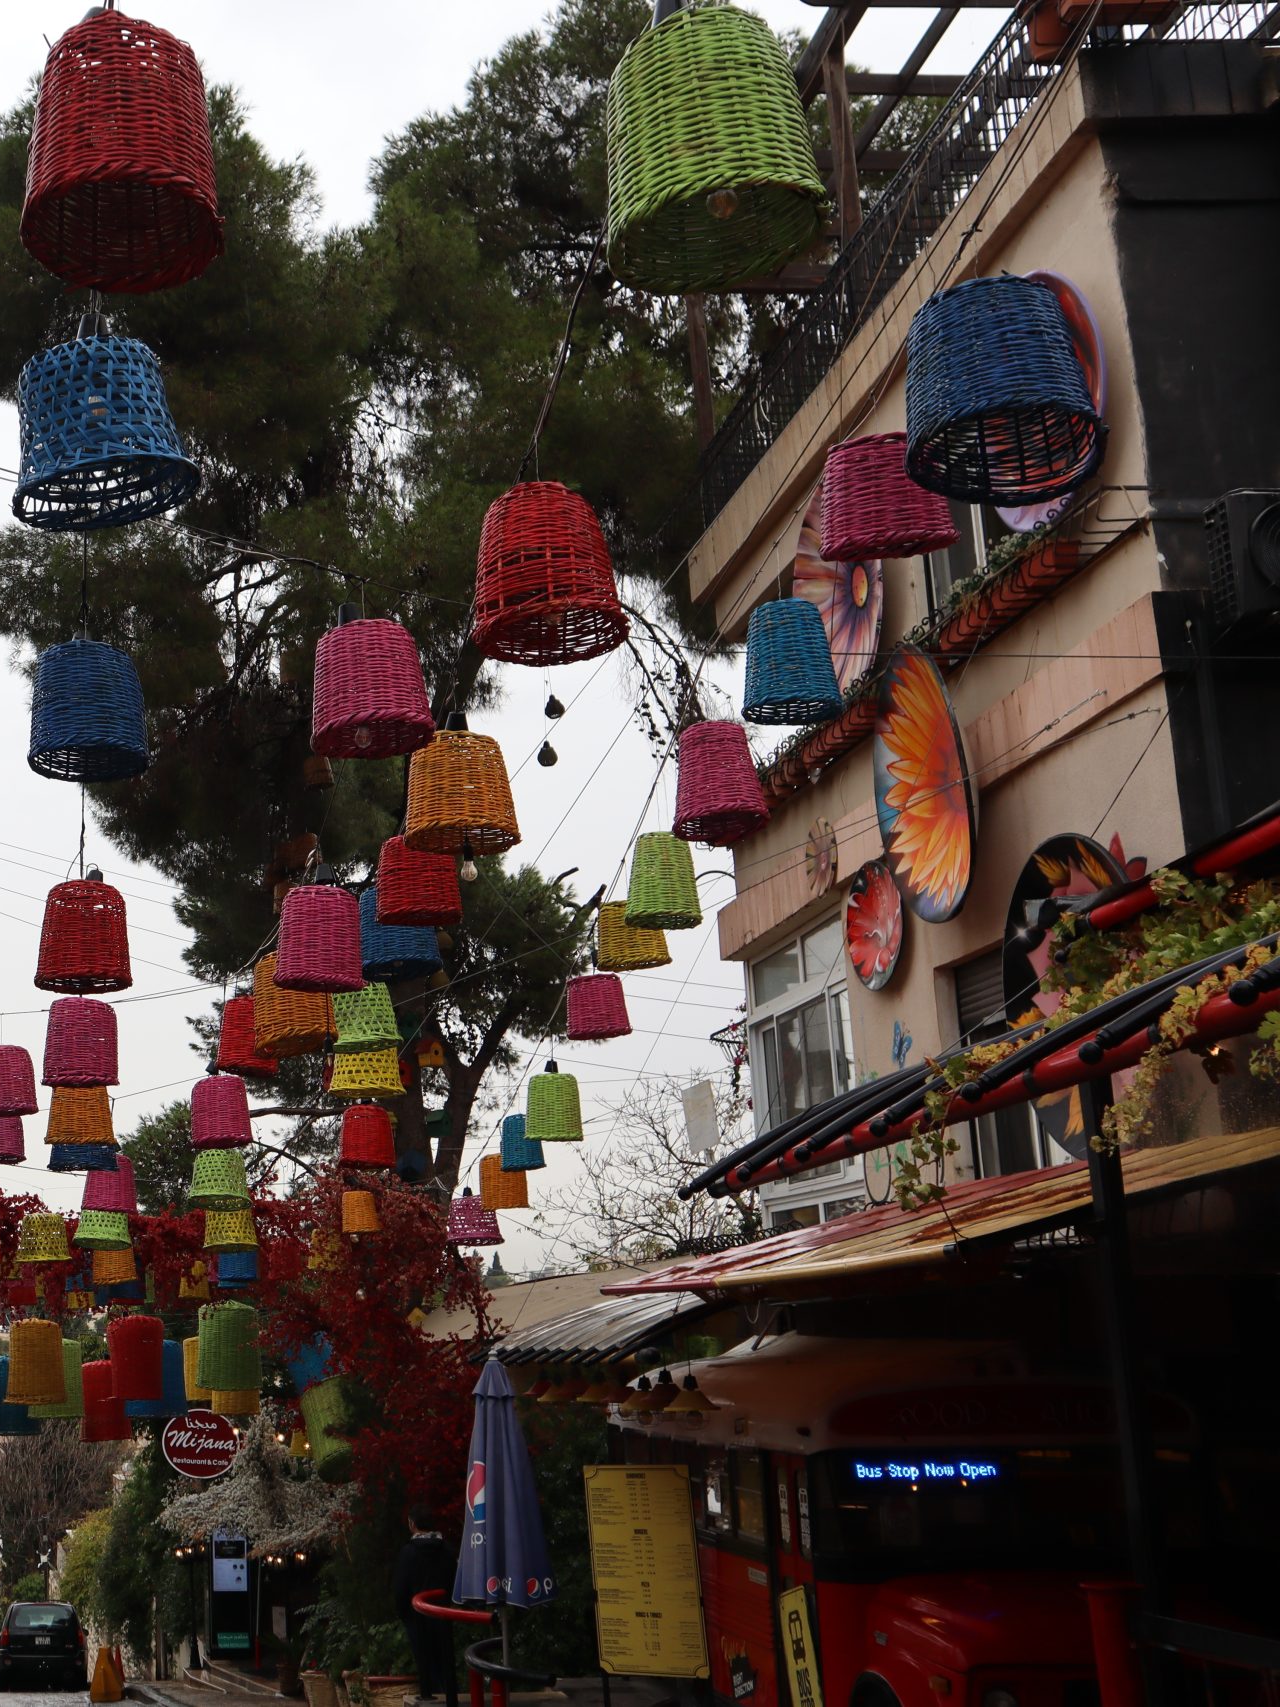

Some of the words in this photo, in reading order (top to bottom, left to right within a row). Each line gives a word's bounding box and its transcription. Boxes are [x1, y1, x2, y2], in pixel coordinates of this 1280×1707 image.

[185, 1417, 218, 1432] ميجنا
[167, 1430, 235, 1454] Mijana
[173, 1457, 207, 1465] Restaurant
[856, 1464, 883, 1478] Bus
[888, 1463, 920, 1481] Stop
[924, 1463, 955, 1477] Now
[959, 1462, 997, 1480] Open
[796, 1667, 812, 1698] BUS
